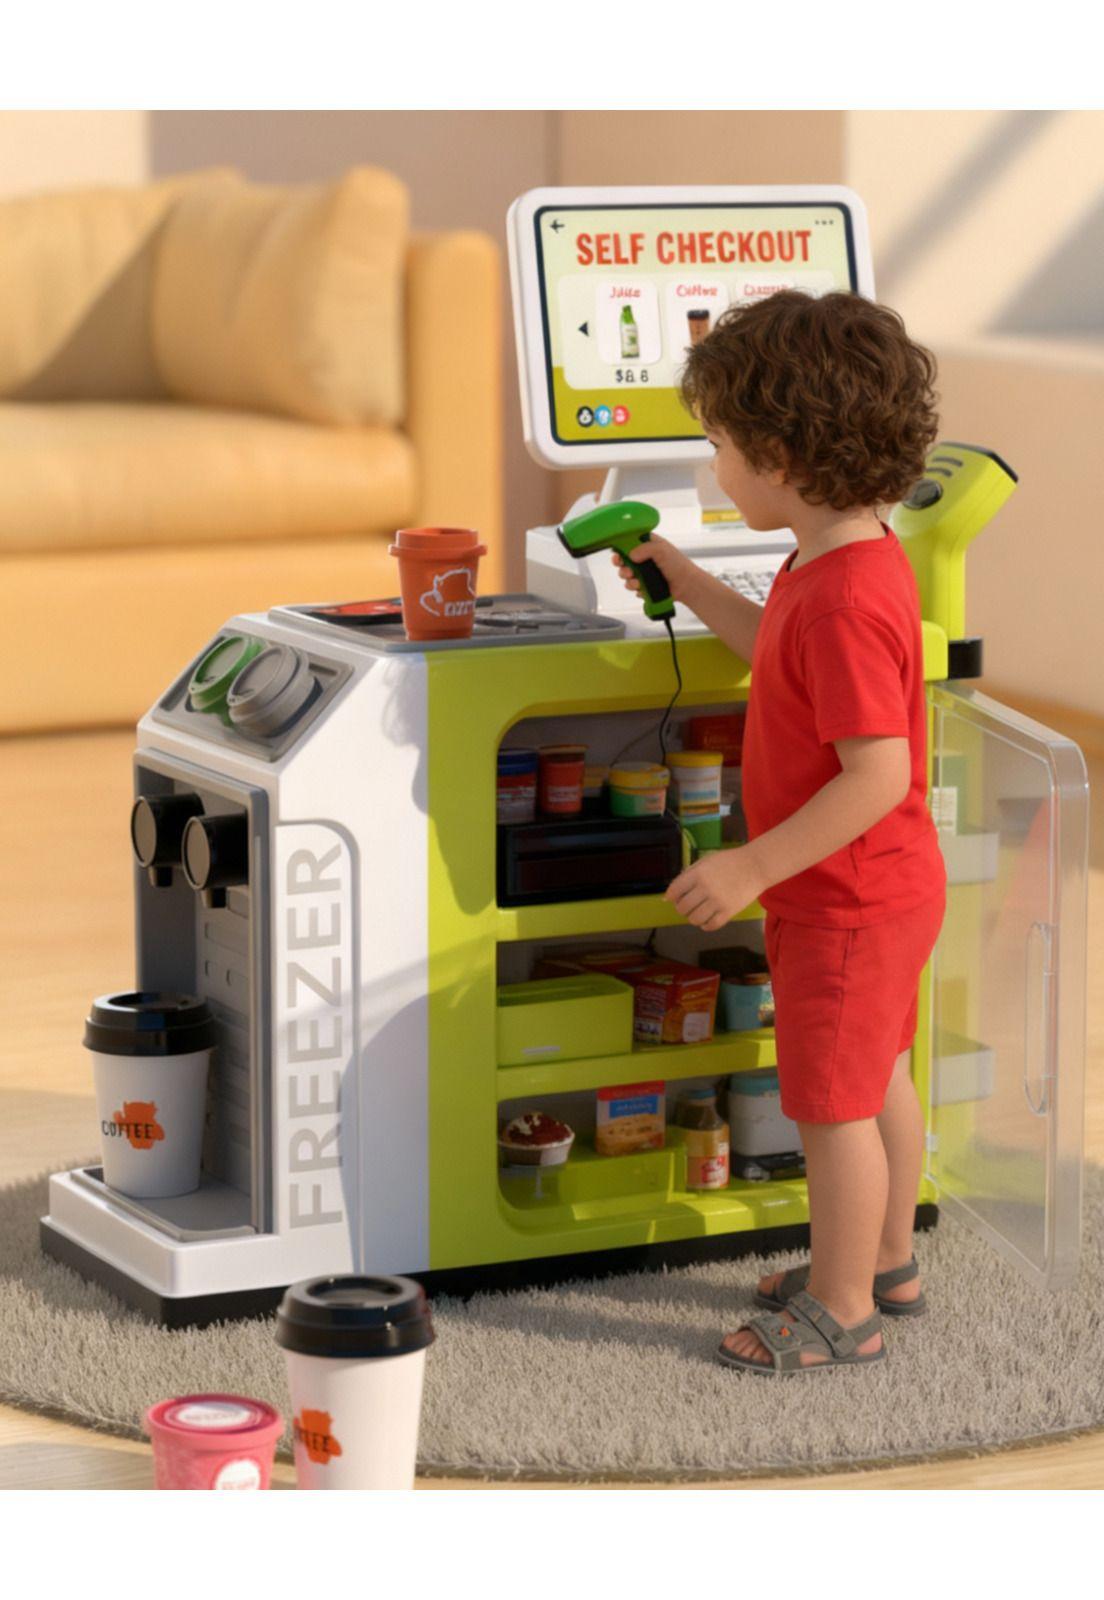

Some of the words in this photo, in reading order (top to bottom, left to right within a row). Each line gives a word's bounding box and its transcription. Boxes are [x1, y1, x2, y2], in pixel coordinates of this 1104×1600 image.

[576, 233, 645, 266] SELF
[656, 230, 812, 265] CHECKOUT
[286, 843, 343, 1229] FREEZER
